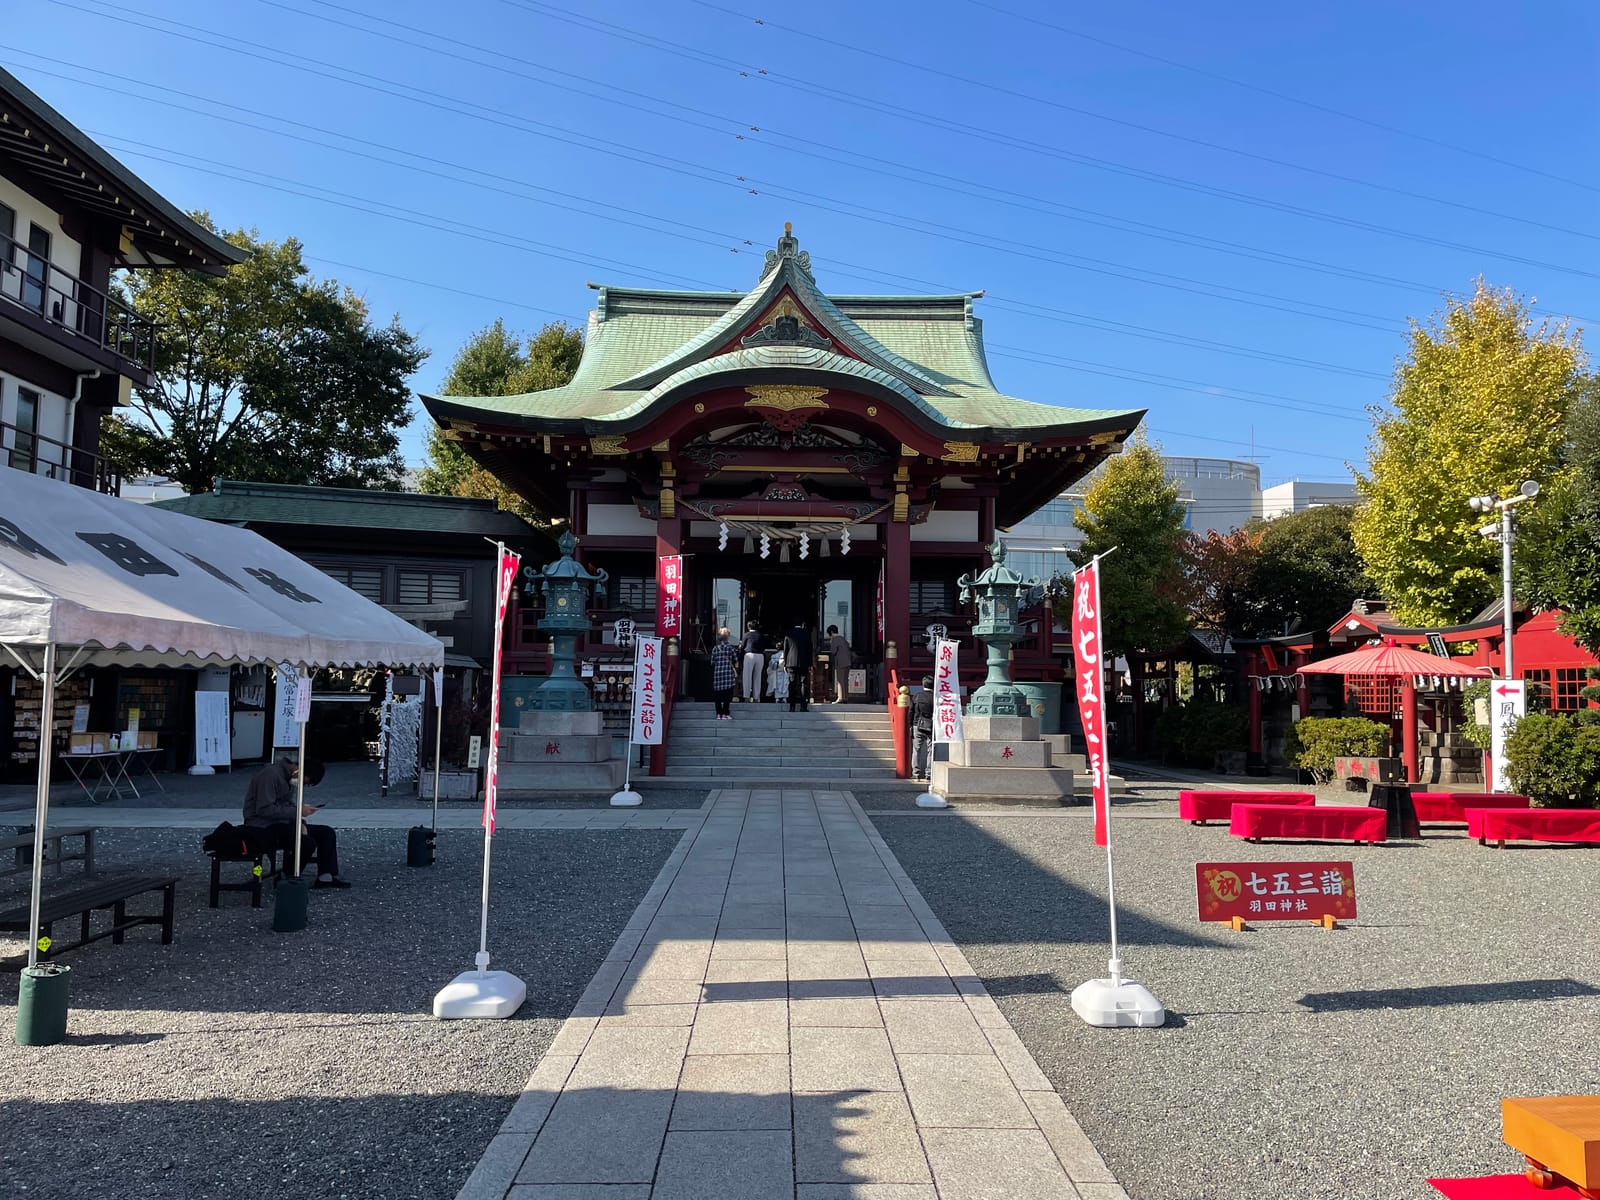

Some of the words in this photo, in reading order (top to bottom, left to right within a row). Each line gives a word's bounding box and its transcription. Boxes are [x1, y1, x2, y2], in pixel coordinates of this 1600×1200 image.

[663, 564, 677, 629] 羽田神社
[1002, 745, 1013, 760] 奉
[1217, 875, 1238, 897] 祝
[1244, 870, 1342, 896] 七五三詣
[1249, 899, 1308, 912] 羽田神社
